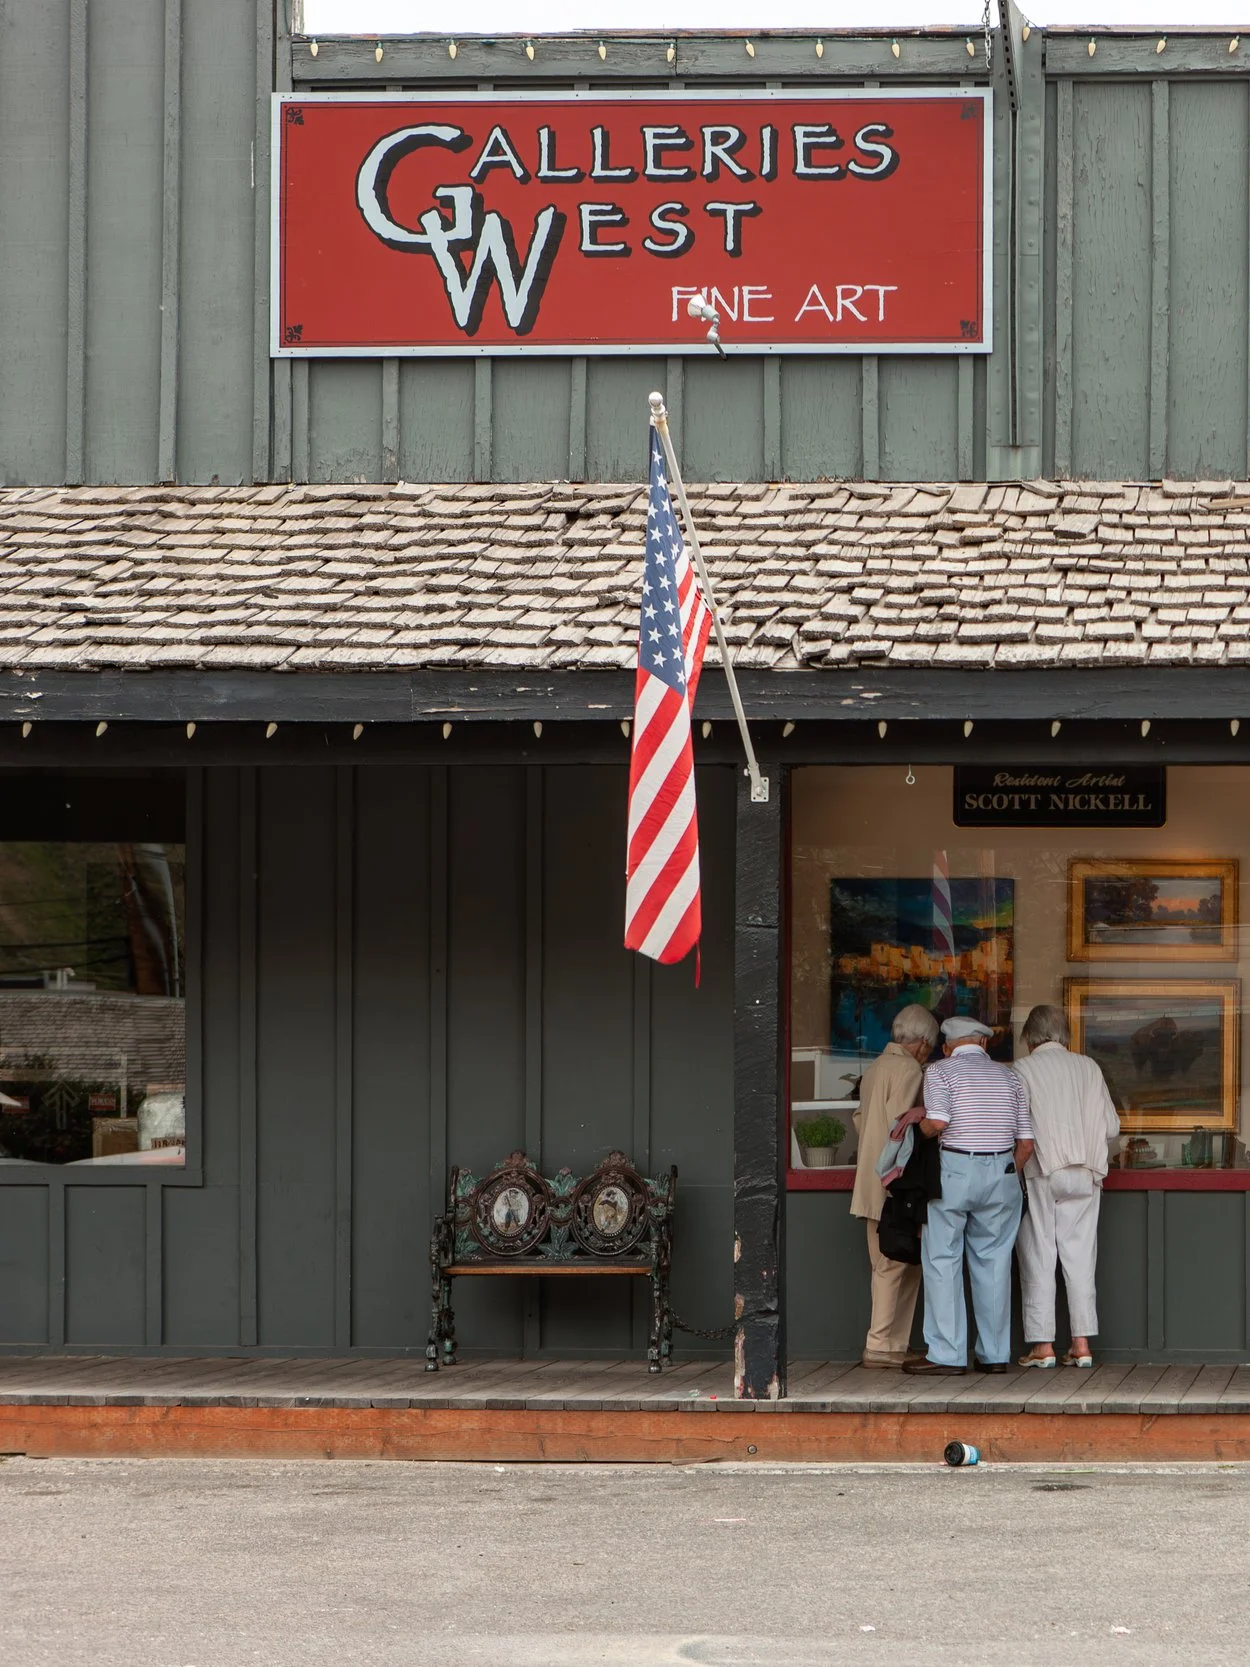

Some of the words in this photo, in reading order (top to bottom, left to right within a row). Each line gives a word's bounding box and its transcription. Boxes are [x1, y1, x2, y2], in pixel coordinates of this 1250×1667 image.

[356, 123, 897, 252] GALLERIES
[420, 201, 757, 333] WEST
[671, 285, 775, 322] FINE
[794, 284, 898, 322] ART
[993, 773, 1060, 787] Resident
[1065, 773, 1126, 788] Artist
[964, 793, 1042, 810] SCOTT
[1048, 793, 1152, 810] NICKELL
